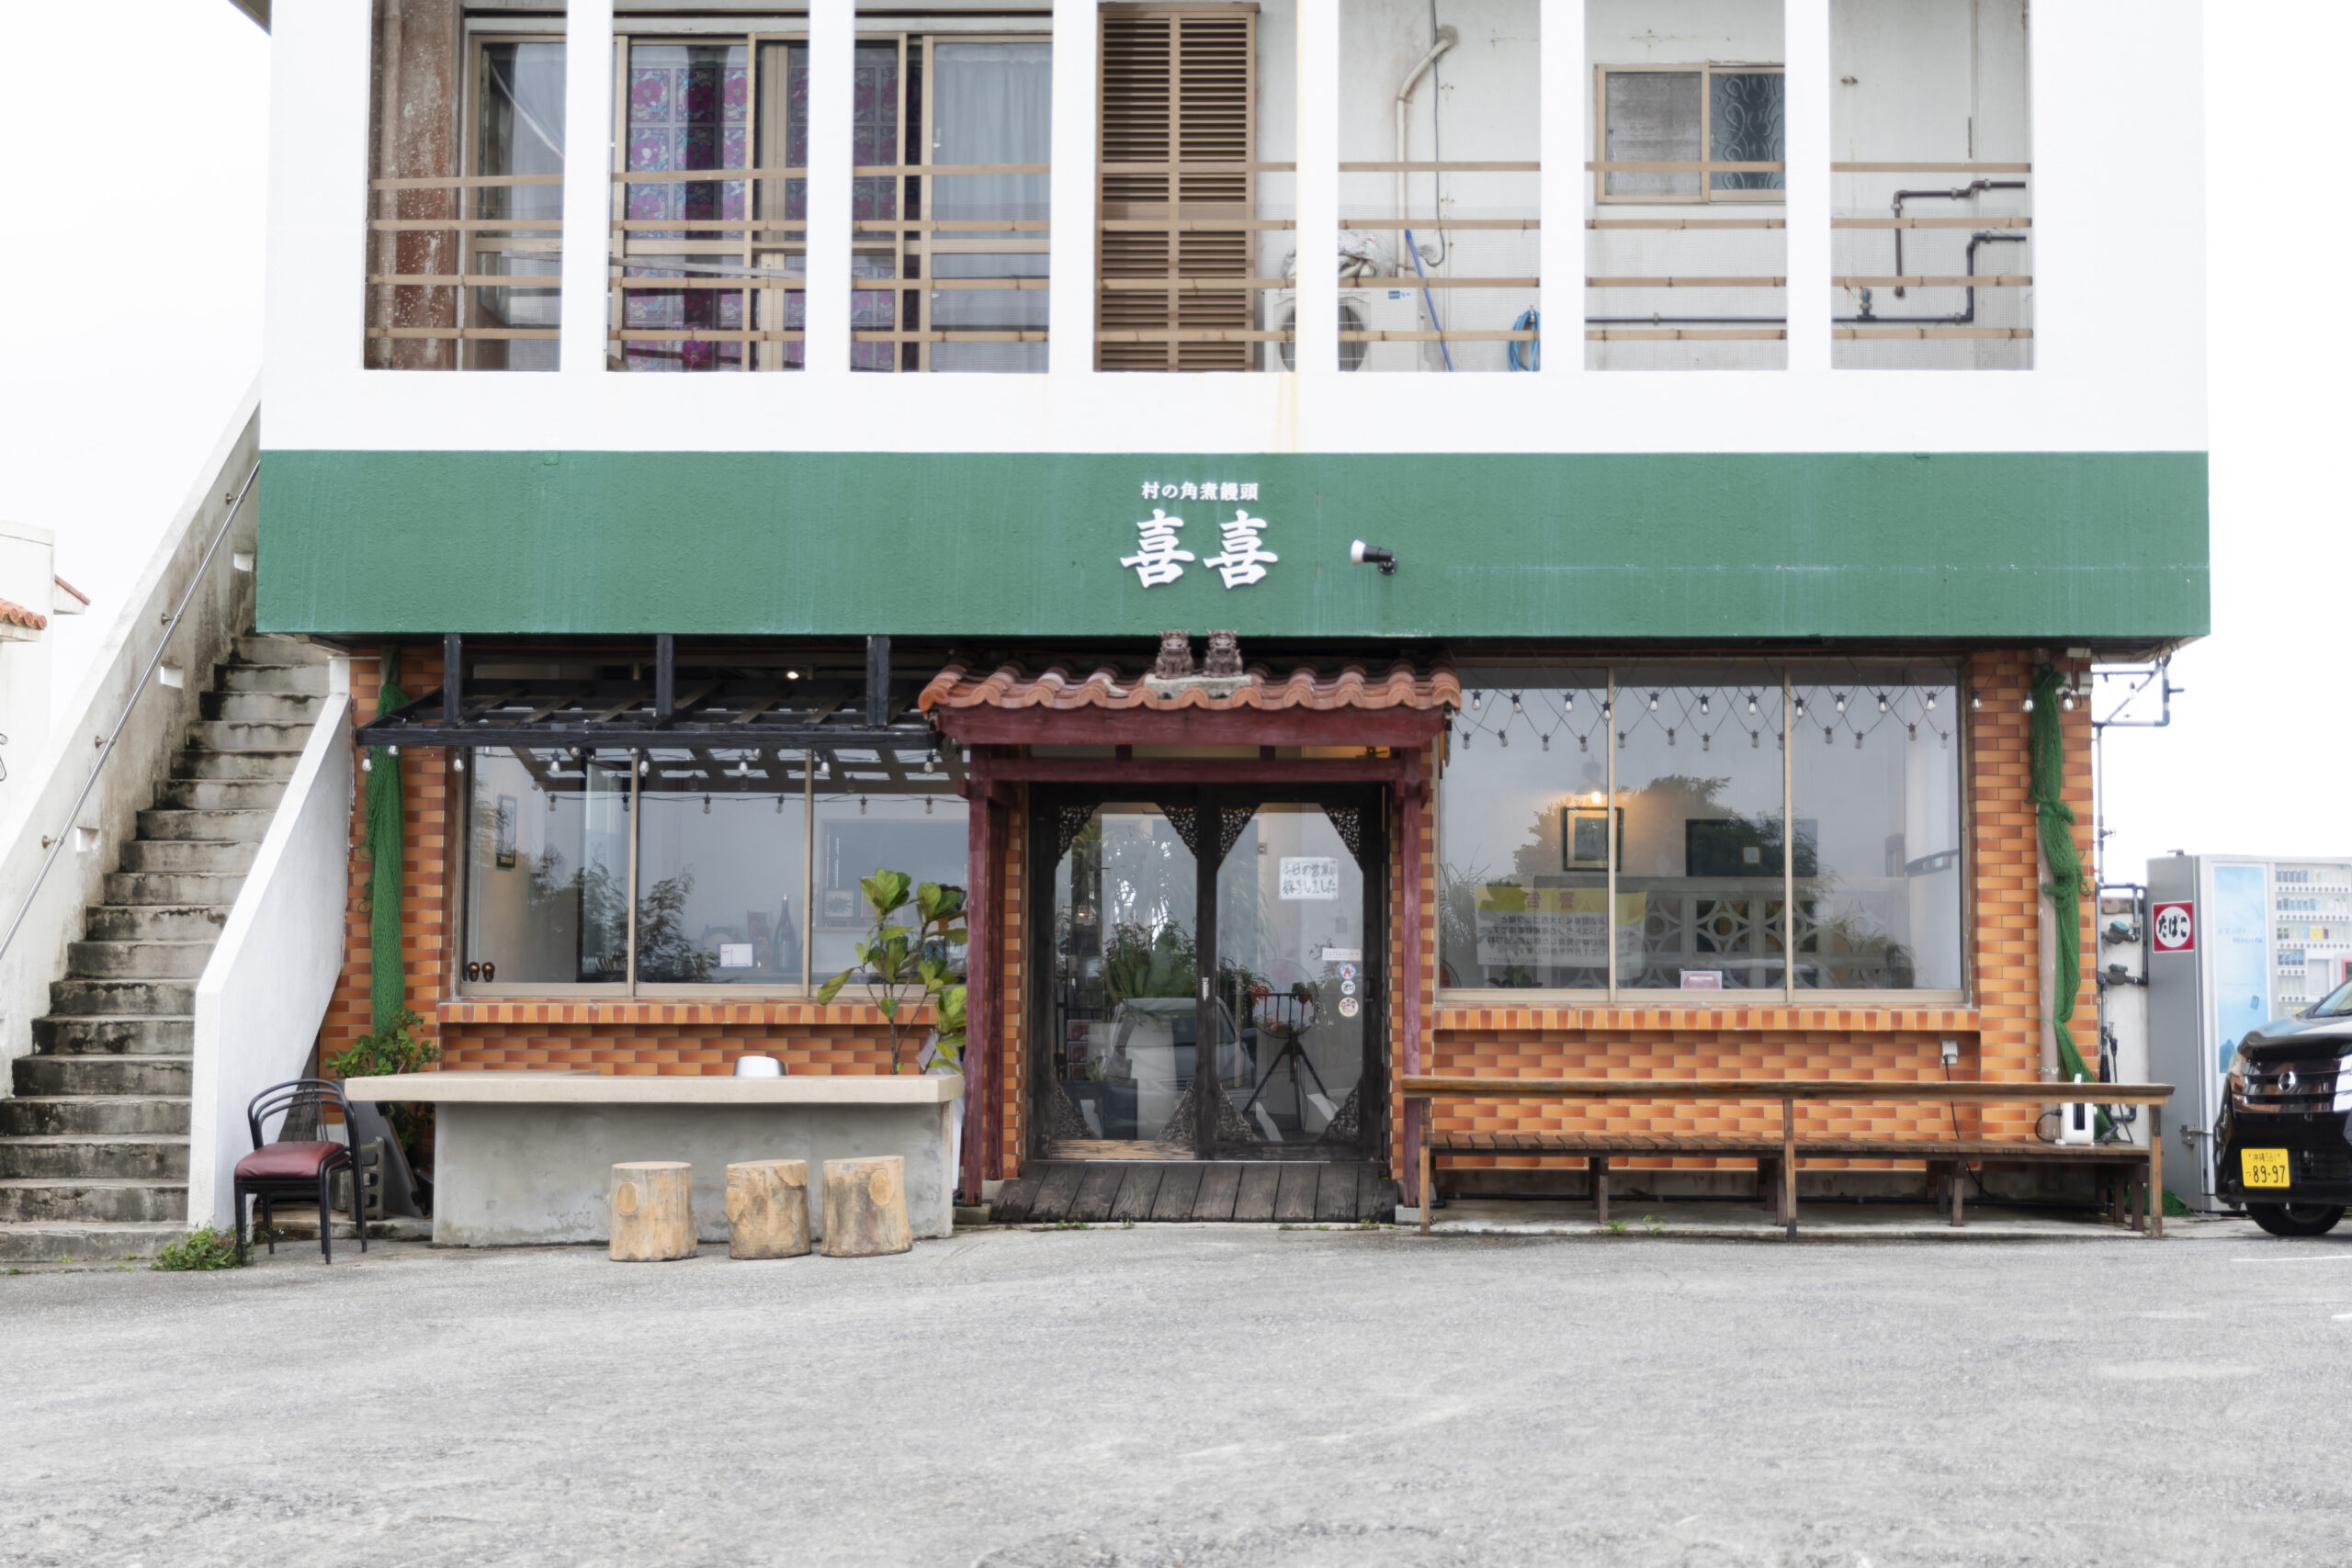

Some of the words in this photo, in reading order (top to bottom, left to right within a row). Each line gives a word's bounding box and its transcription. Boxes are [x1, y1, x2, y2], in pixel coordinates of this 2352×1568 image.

[1141, 481, 1259, 502] 村の角煮饅頭
[1120, 508, 1279, 589] 喜喜
[2158, 914, 2188, 938] たばこ
